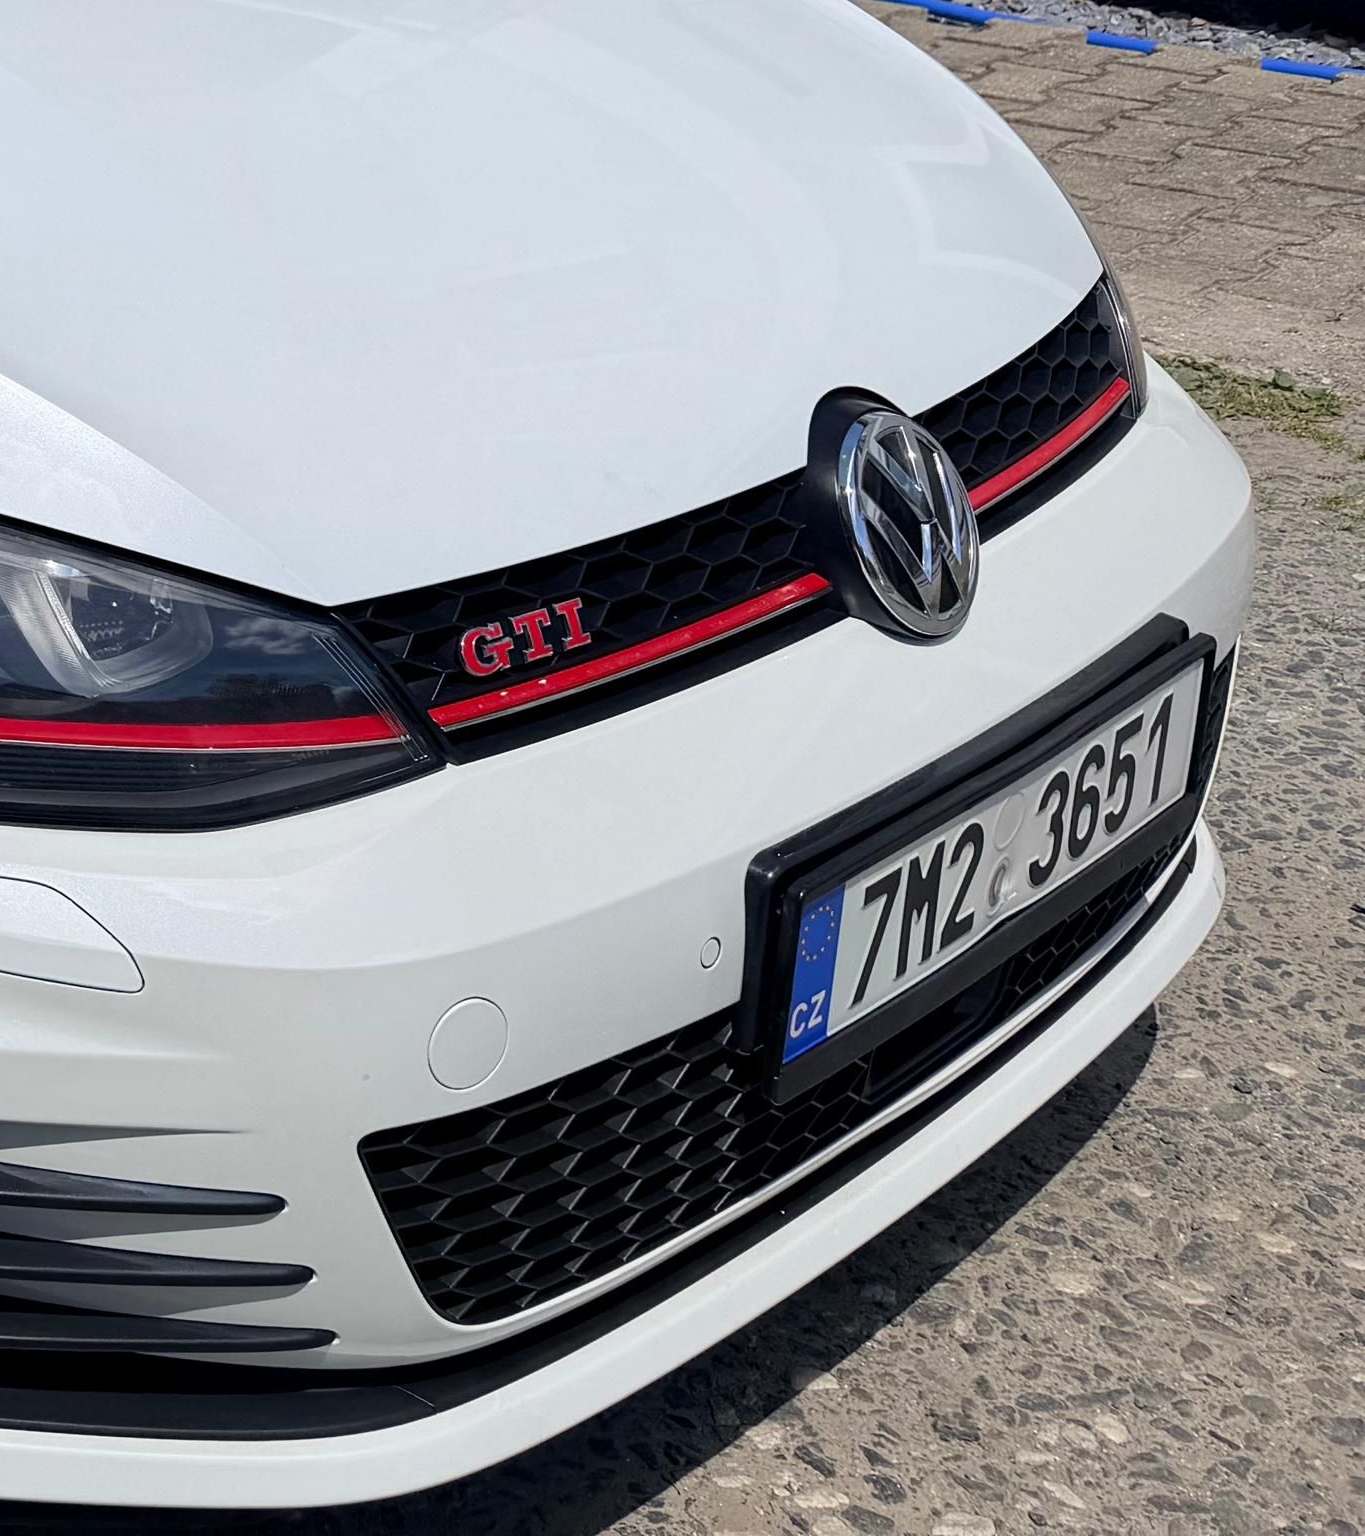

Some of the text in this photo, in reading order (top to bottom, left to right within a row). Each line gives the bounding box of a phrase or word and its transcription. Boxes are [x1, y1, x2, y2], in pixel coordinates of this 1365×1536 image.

[460, 597, 592, 677] GTI
[848, 693, 1175, 1011] 7M2 3651
[789, 990, 826, 1040] CZ
